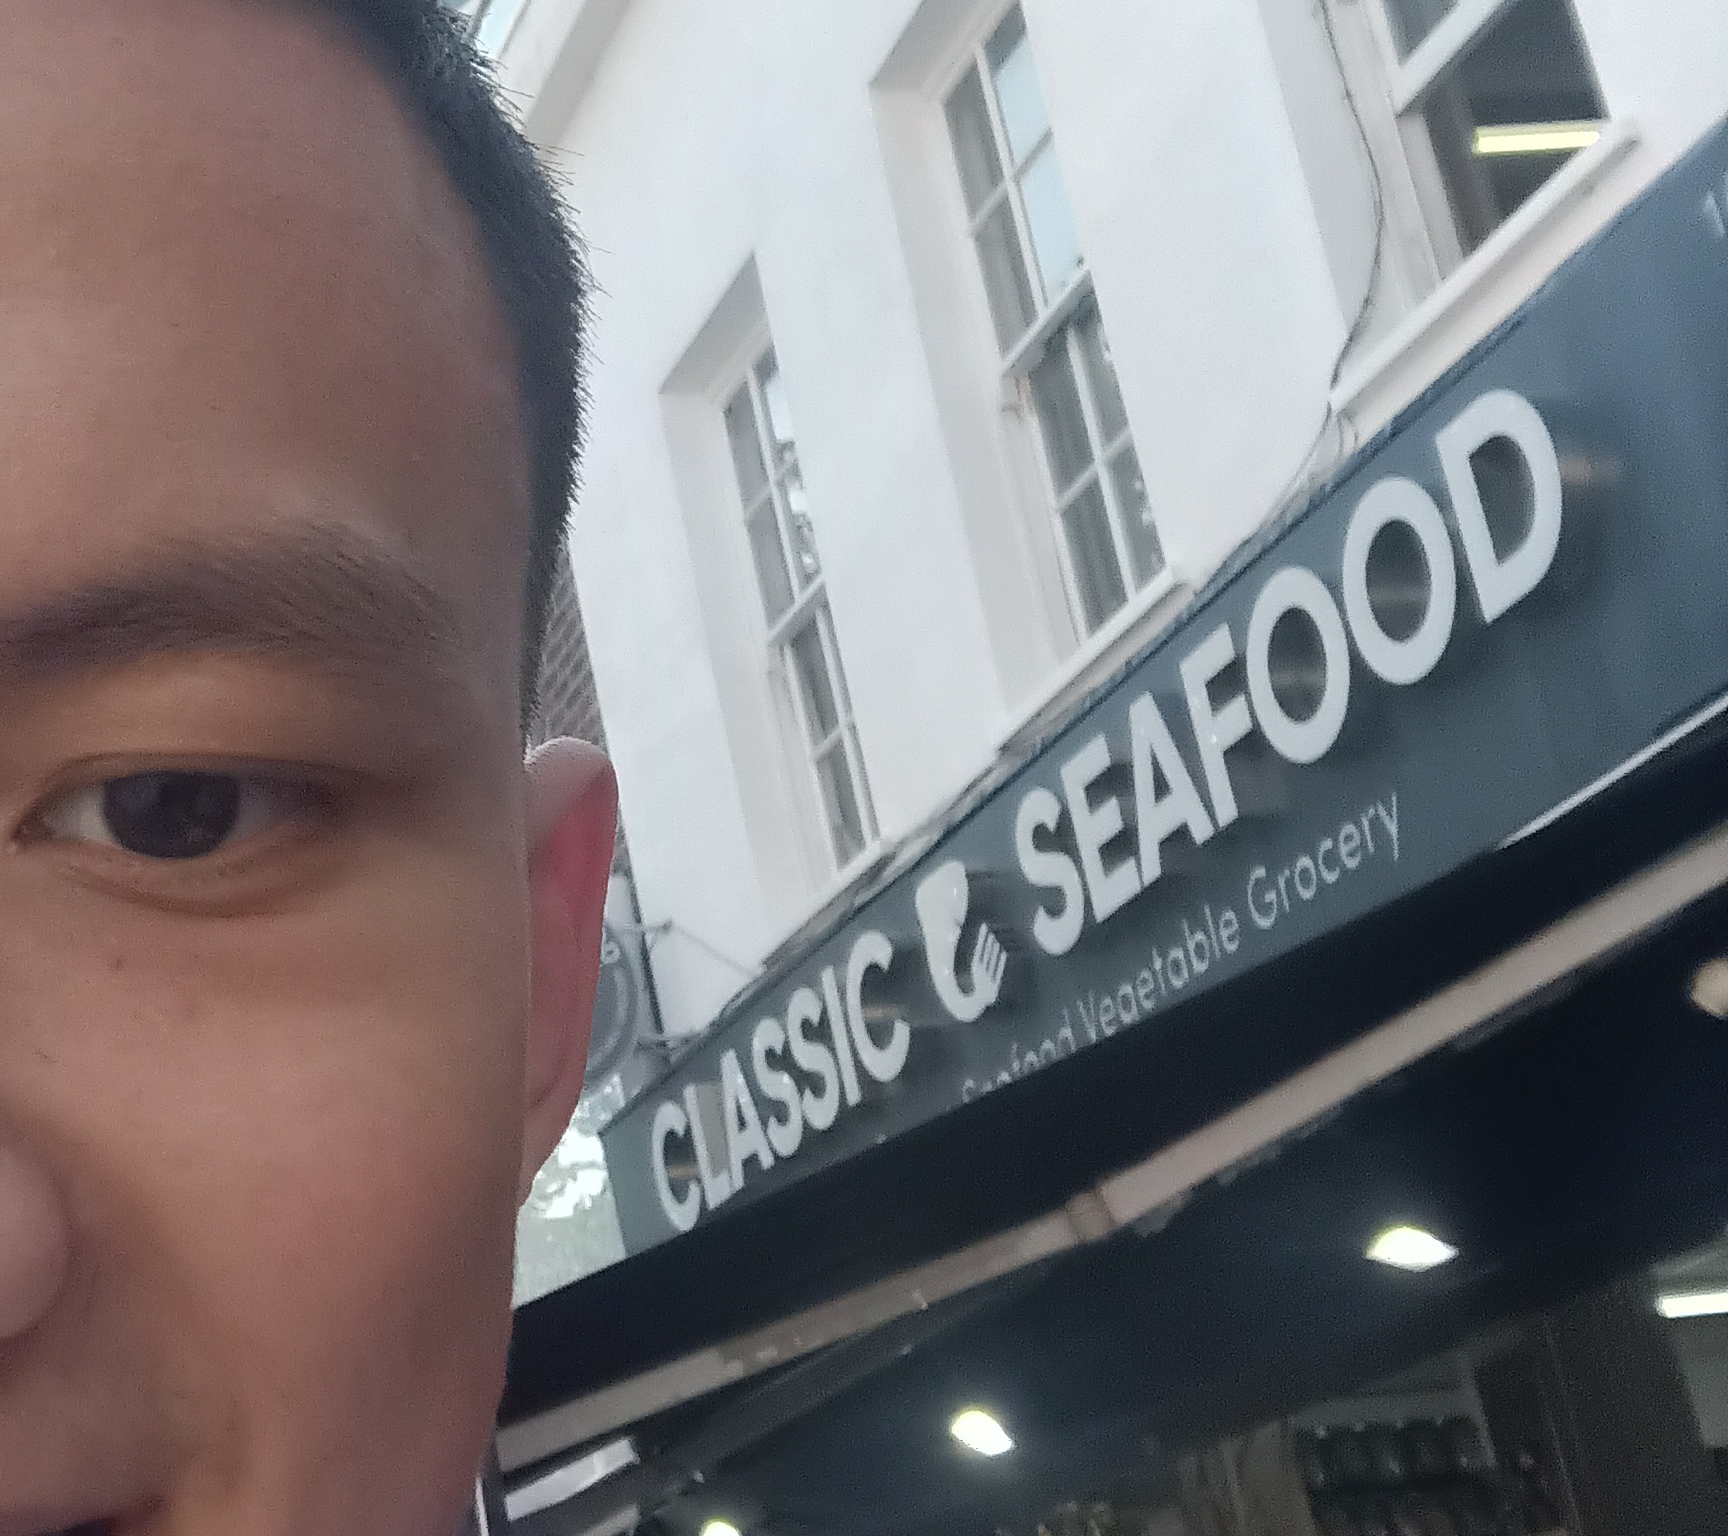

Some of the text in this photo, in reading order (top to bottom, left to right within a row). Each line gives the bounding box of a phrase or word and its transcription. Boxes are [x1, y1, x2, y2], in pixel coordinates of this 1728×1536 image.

[651, 388, 1563, 1232] CLASSIC SEAFOOD
[1247, 791, 1399, 930] Grocery
